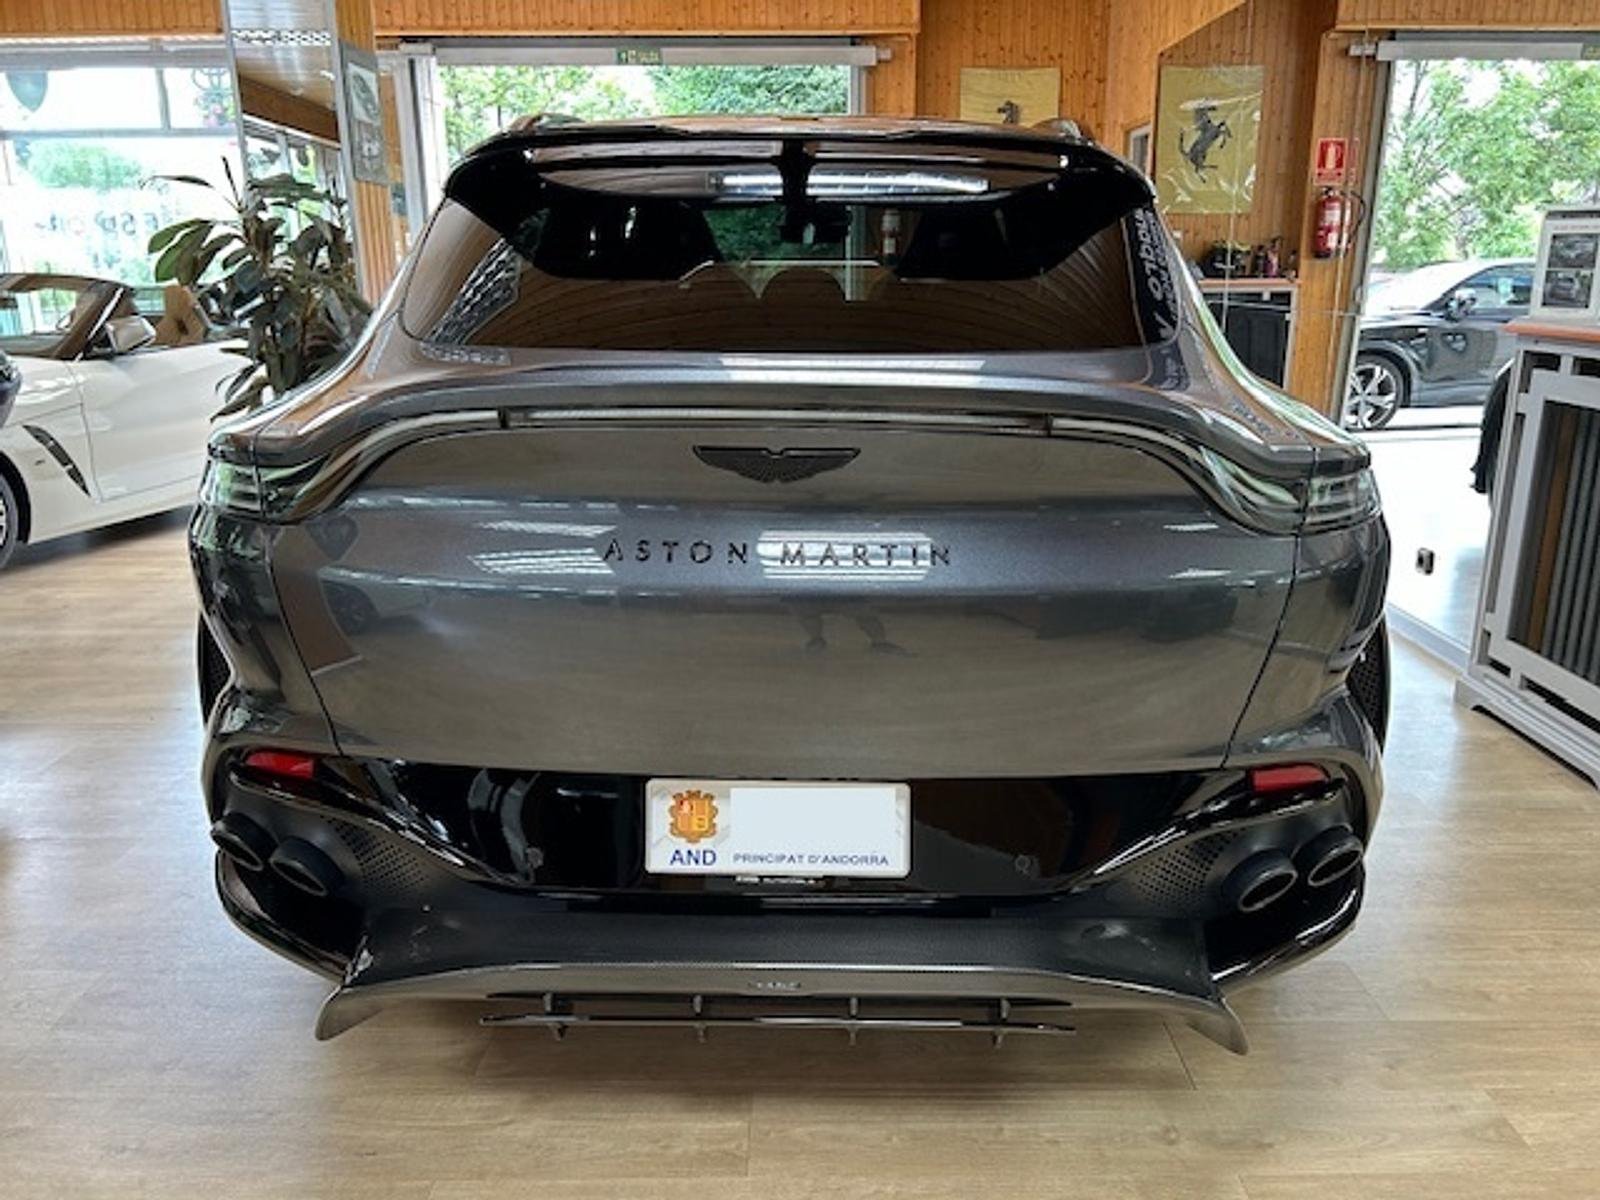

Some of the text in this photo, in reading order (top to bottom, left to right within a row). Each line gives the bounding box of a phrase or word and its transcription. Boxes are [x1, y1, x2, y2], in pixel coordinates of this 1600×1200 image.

[603, 538, 952, 567] ASTON MARTIN
[670, 849, 717, 866] AND
[733, 853, 889, 866] PRINCIPAT D'ANDORRA
